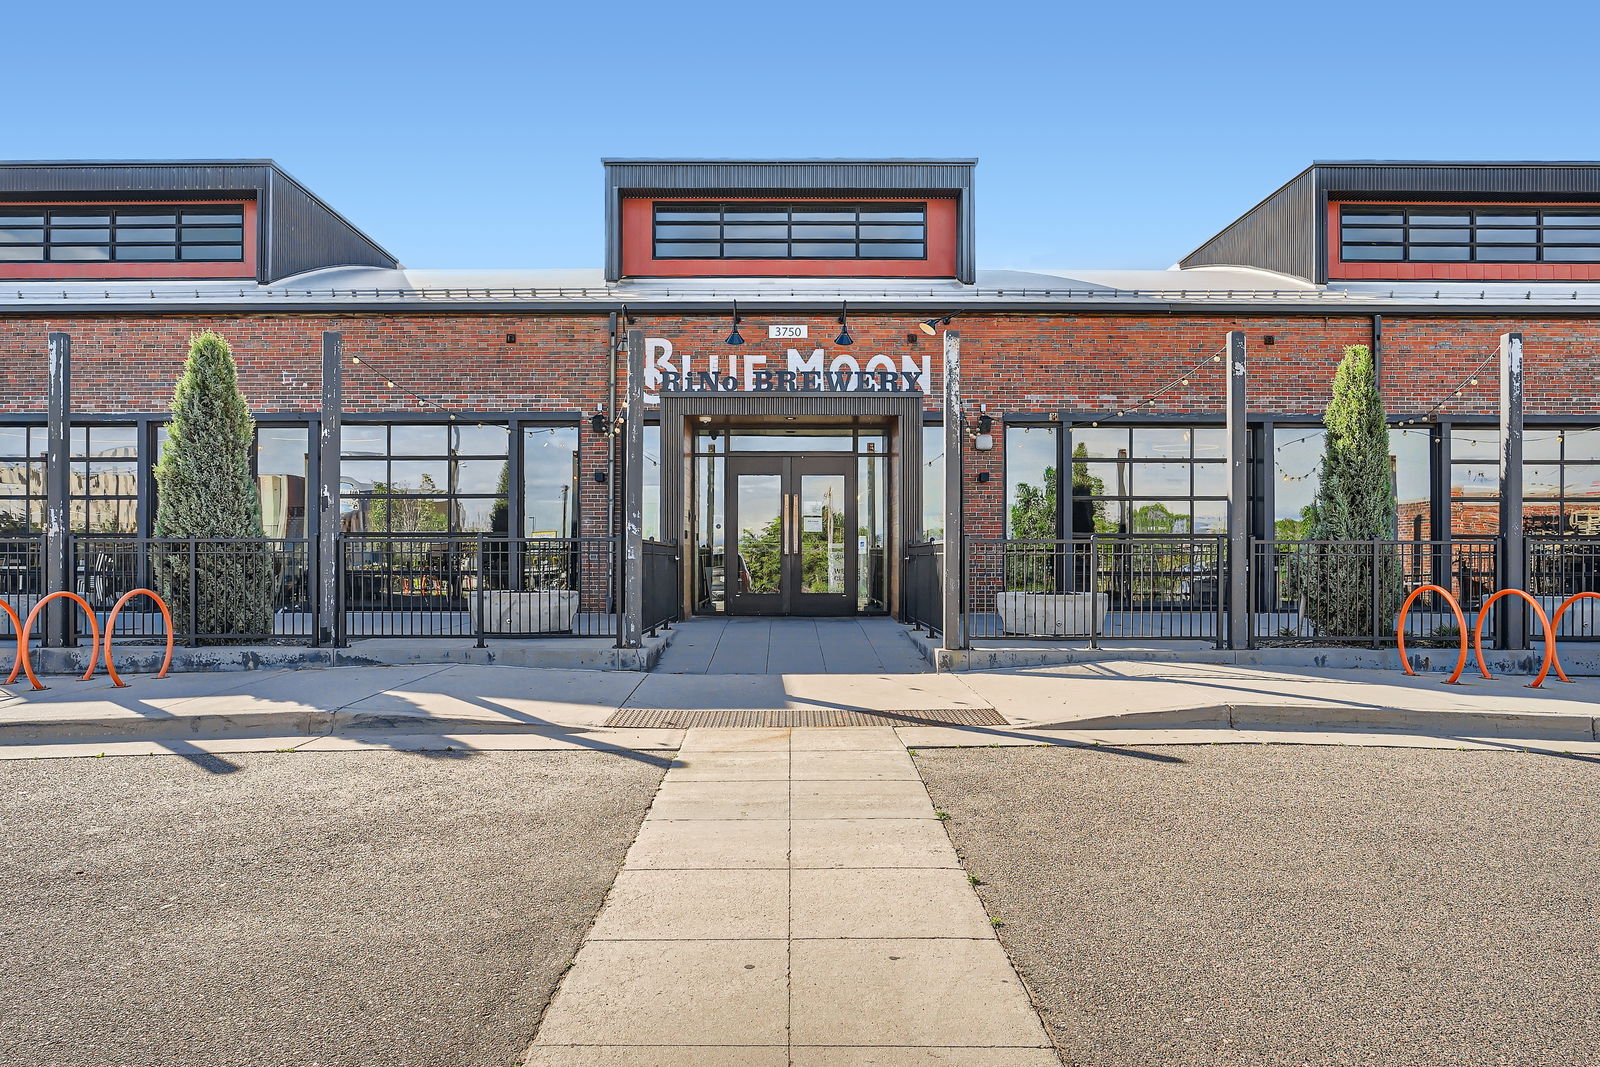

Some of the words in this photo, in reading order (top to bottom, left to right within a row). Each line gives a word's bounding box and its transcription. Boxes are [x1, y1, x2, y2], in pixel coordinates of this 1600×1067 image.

[775, 327, 801, 337] 3750
[660, 371, 738, 392] RiNo
[753, 371, 923, 392] BREWERY
[787, 349, 931, 394] MOON
